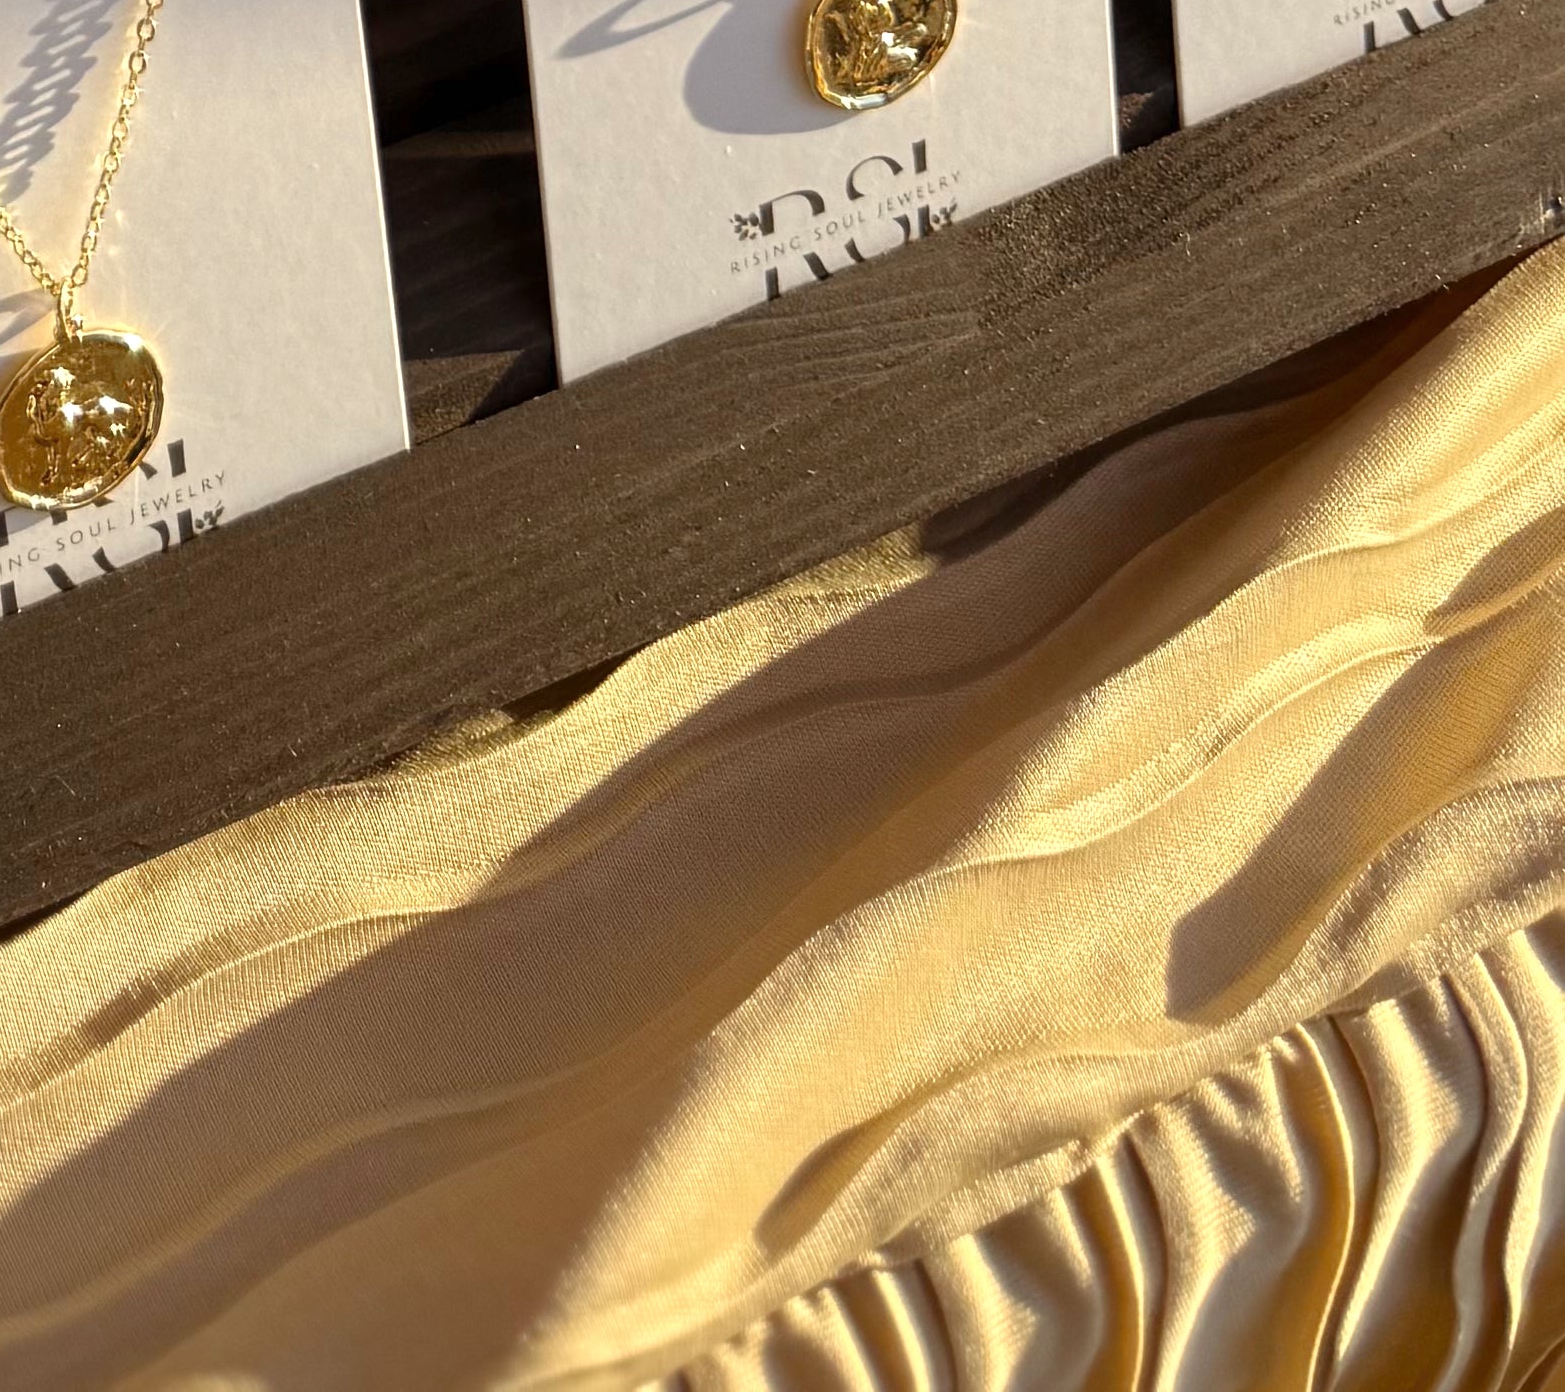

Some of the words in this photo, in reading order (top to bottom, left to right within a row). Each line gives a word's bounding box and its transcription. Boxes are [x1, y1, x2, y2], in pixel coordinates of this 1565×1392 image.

[730, 235, 801, 275] RISING
[814, 210, 864, 242] SOUL
[877, 170, 962, 219] JEWELRY
[56, 518, 116, 552] SOUL
[130, 470, 226, 525] JEWELRY
